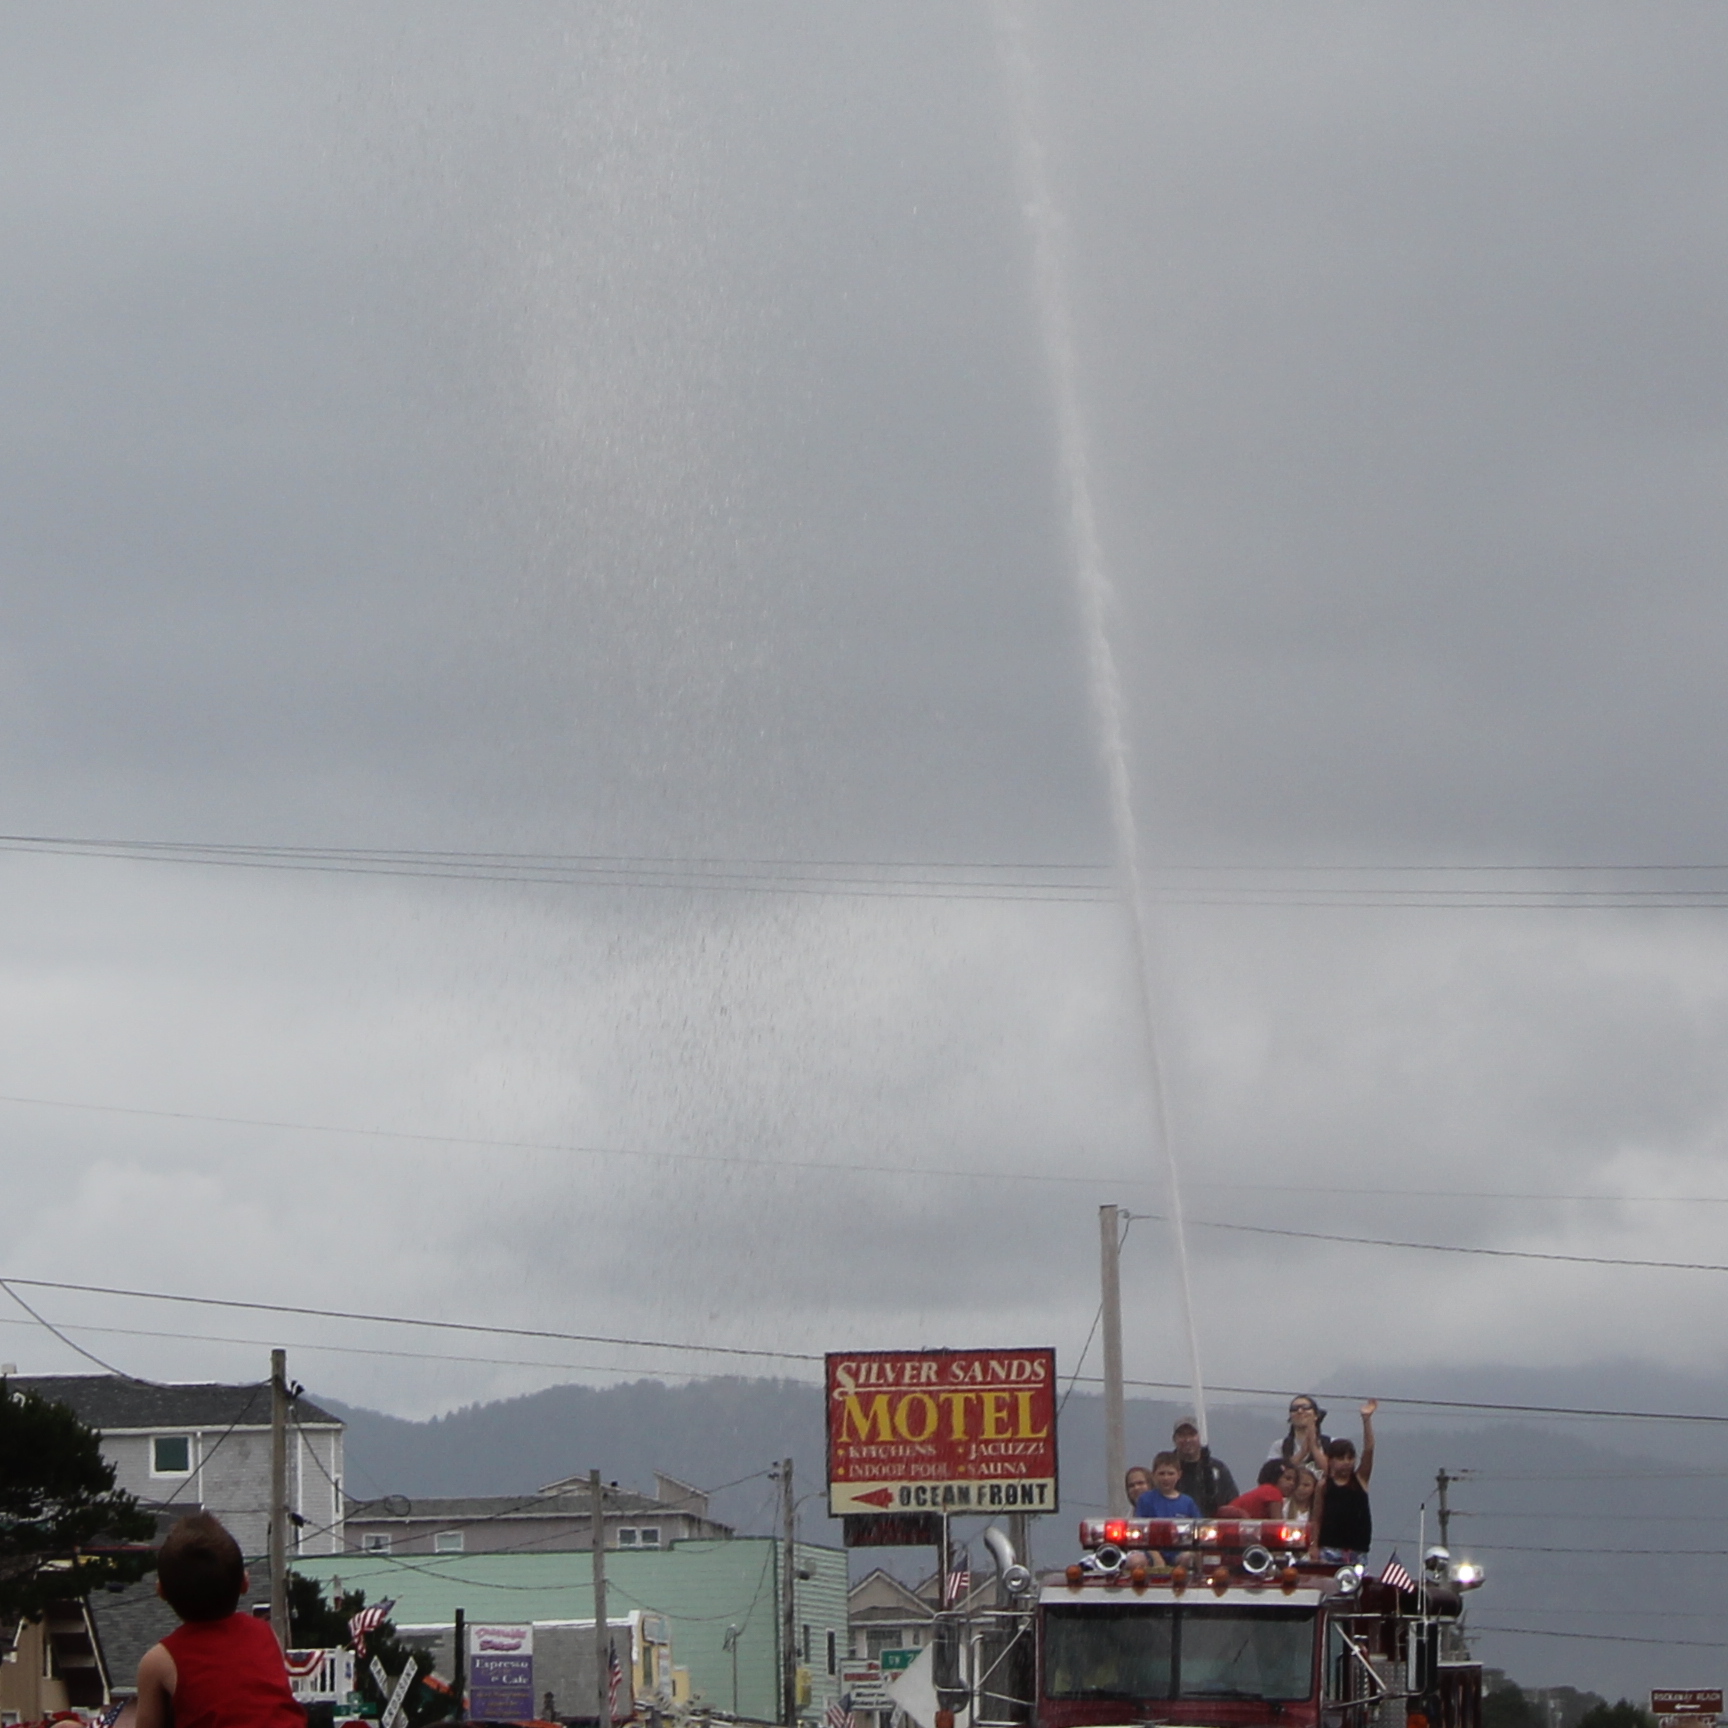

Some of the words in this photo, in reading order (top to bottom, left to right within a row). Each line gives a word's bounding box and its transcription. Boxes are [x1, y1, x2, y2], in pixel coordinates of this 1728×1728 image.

[834, 1360, 939, 1391] SILVER
[951, 1358, 1047, 1383] SANDS
[836, 1390, 1049, 1443] MOTEL
[848, 1443, 937, 1459] KITCHENS
[969, 1441, 1045, 1460] JACUZZI
[848, 1463, 907, 1478] INDOOR
[910, 1462, 949, 1477] POOL
[966, 1461, 1027, 1475] SAUNA
[898, 1483, 971, 1507] OCEAN
[977, 1482, 1049, 1507] FRONT
[475, 1658, 528, 1670] Espresso
